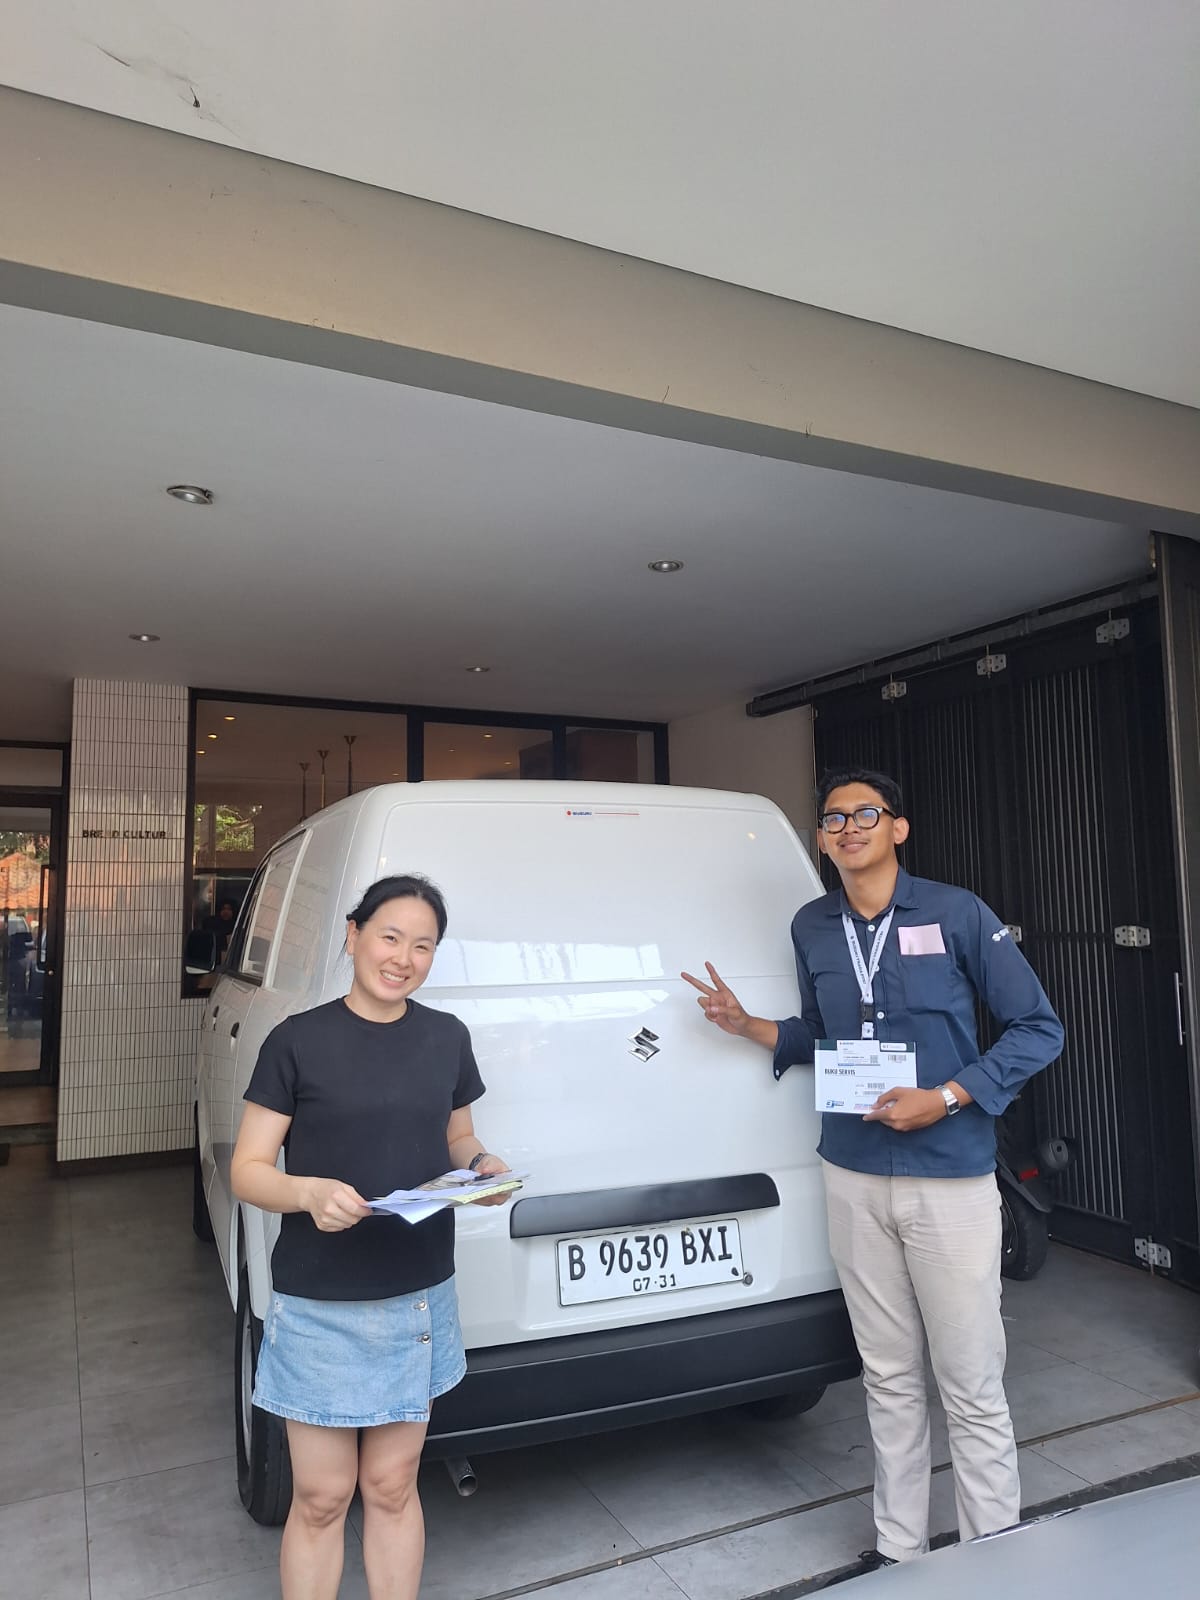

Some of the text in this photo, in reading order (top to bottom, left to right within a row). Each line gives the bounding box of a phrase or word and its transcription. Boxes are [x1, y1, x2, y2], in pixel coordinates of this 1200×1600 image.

[82, 830, 120, 839] BRED
[568, 1226, 733, 1281] B 9639 BXI
